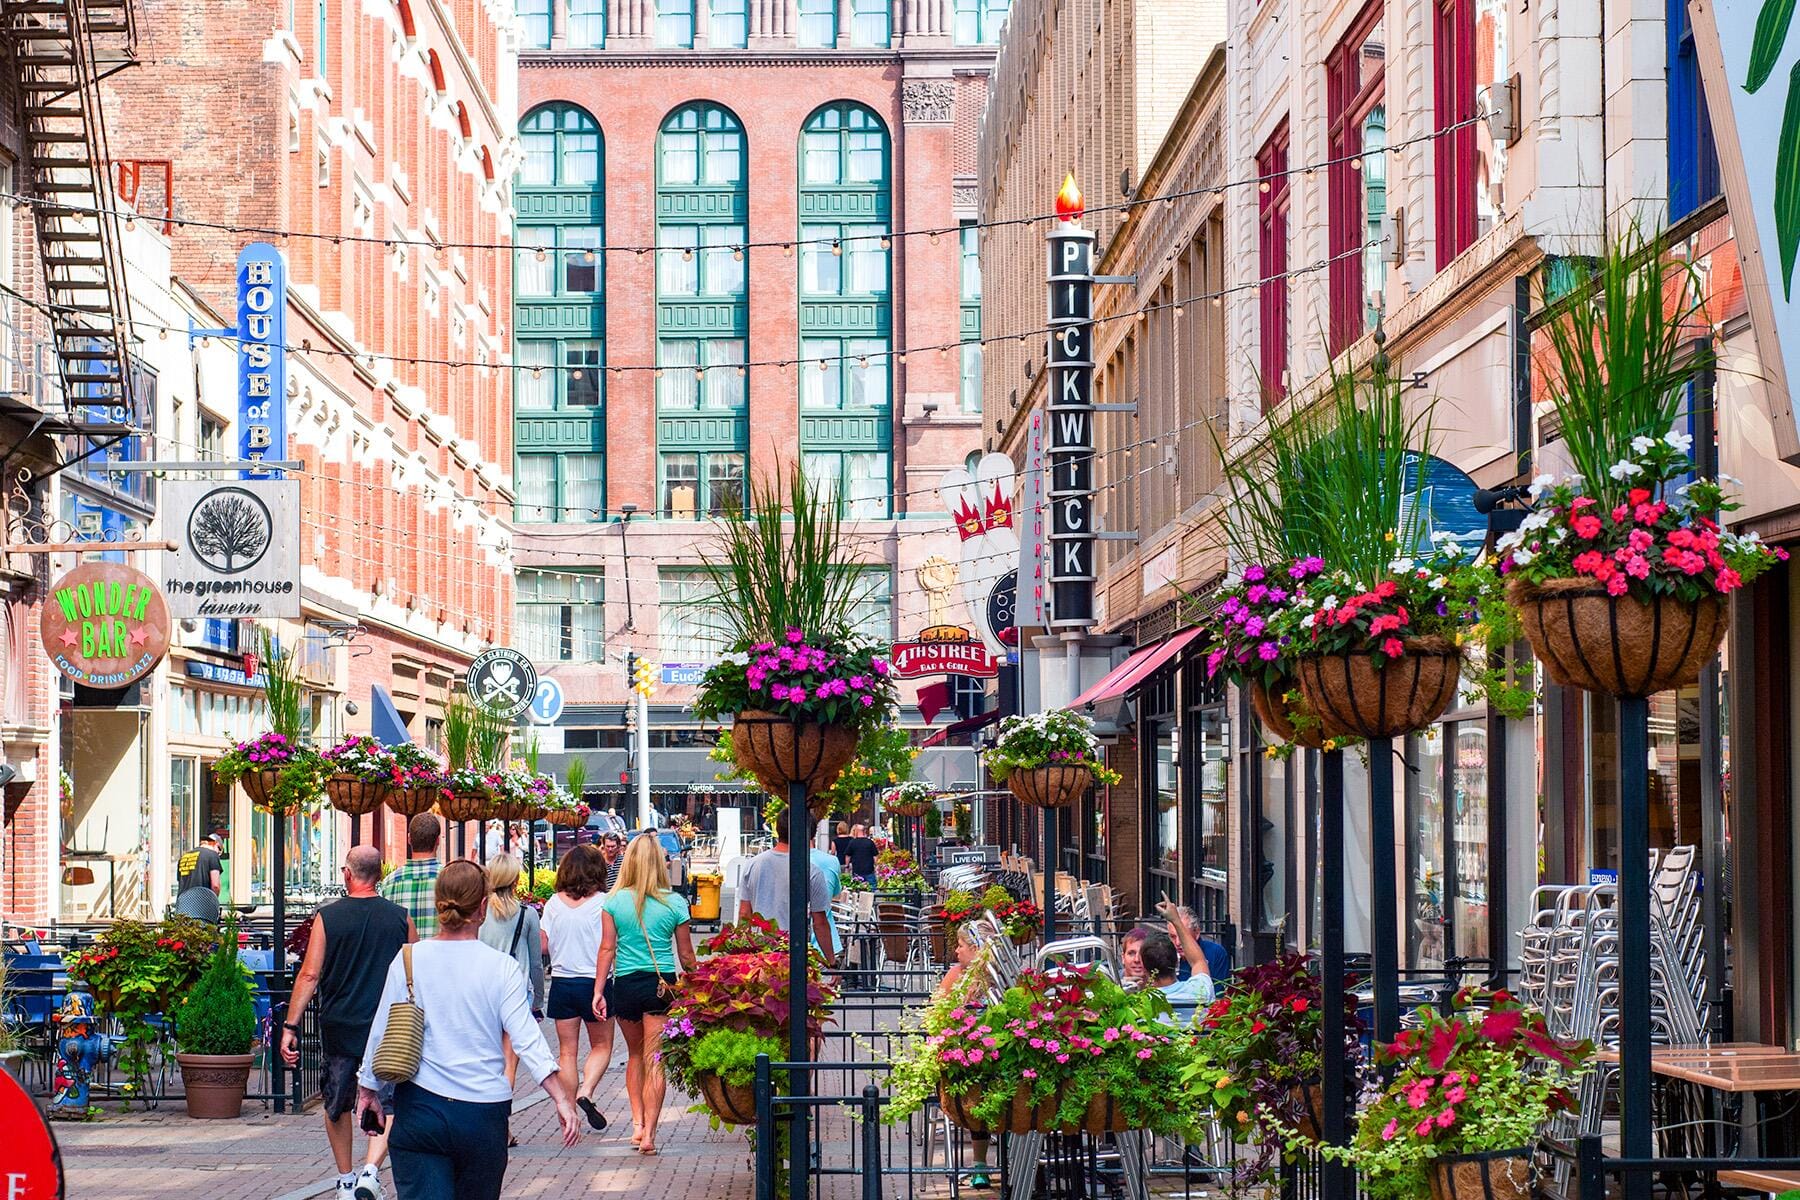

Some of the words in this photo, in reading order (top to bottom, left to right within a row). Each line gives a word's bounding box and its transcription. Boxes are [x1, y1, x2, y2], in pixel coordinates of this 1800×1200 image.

[246, 261, 274, 397] HOUSE
[247, 401, 271, 420] of
[1060, 241, 1085, 574] PICKWICK
[1033, 415, 1042, 621] RESTAURANT
[55, 580, 152, 623] WONDER
[197, 598, 262, 616] tavern
[82, 620, 127, 659] BAR
[895, 646, 926, 669] 4TH
[928, 644, 991, 668] STREET
[55, 654, 84, 680] FOOD
[89, 672, 125, 685] DRINK
[129, 652, 153, 680] JAZZ
[920, 663, 937, 672] BAR
[946, 661, 969, 672] GRILL
